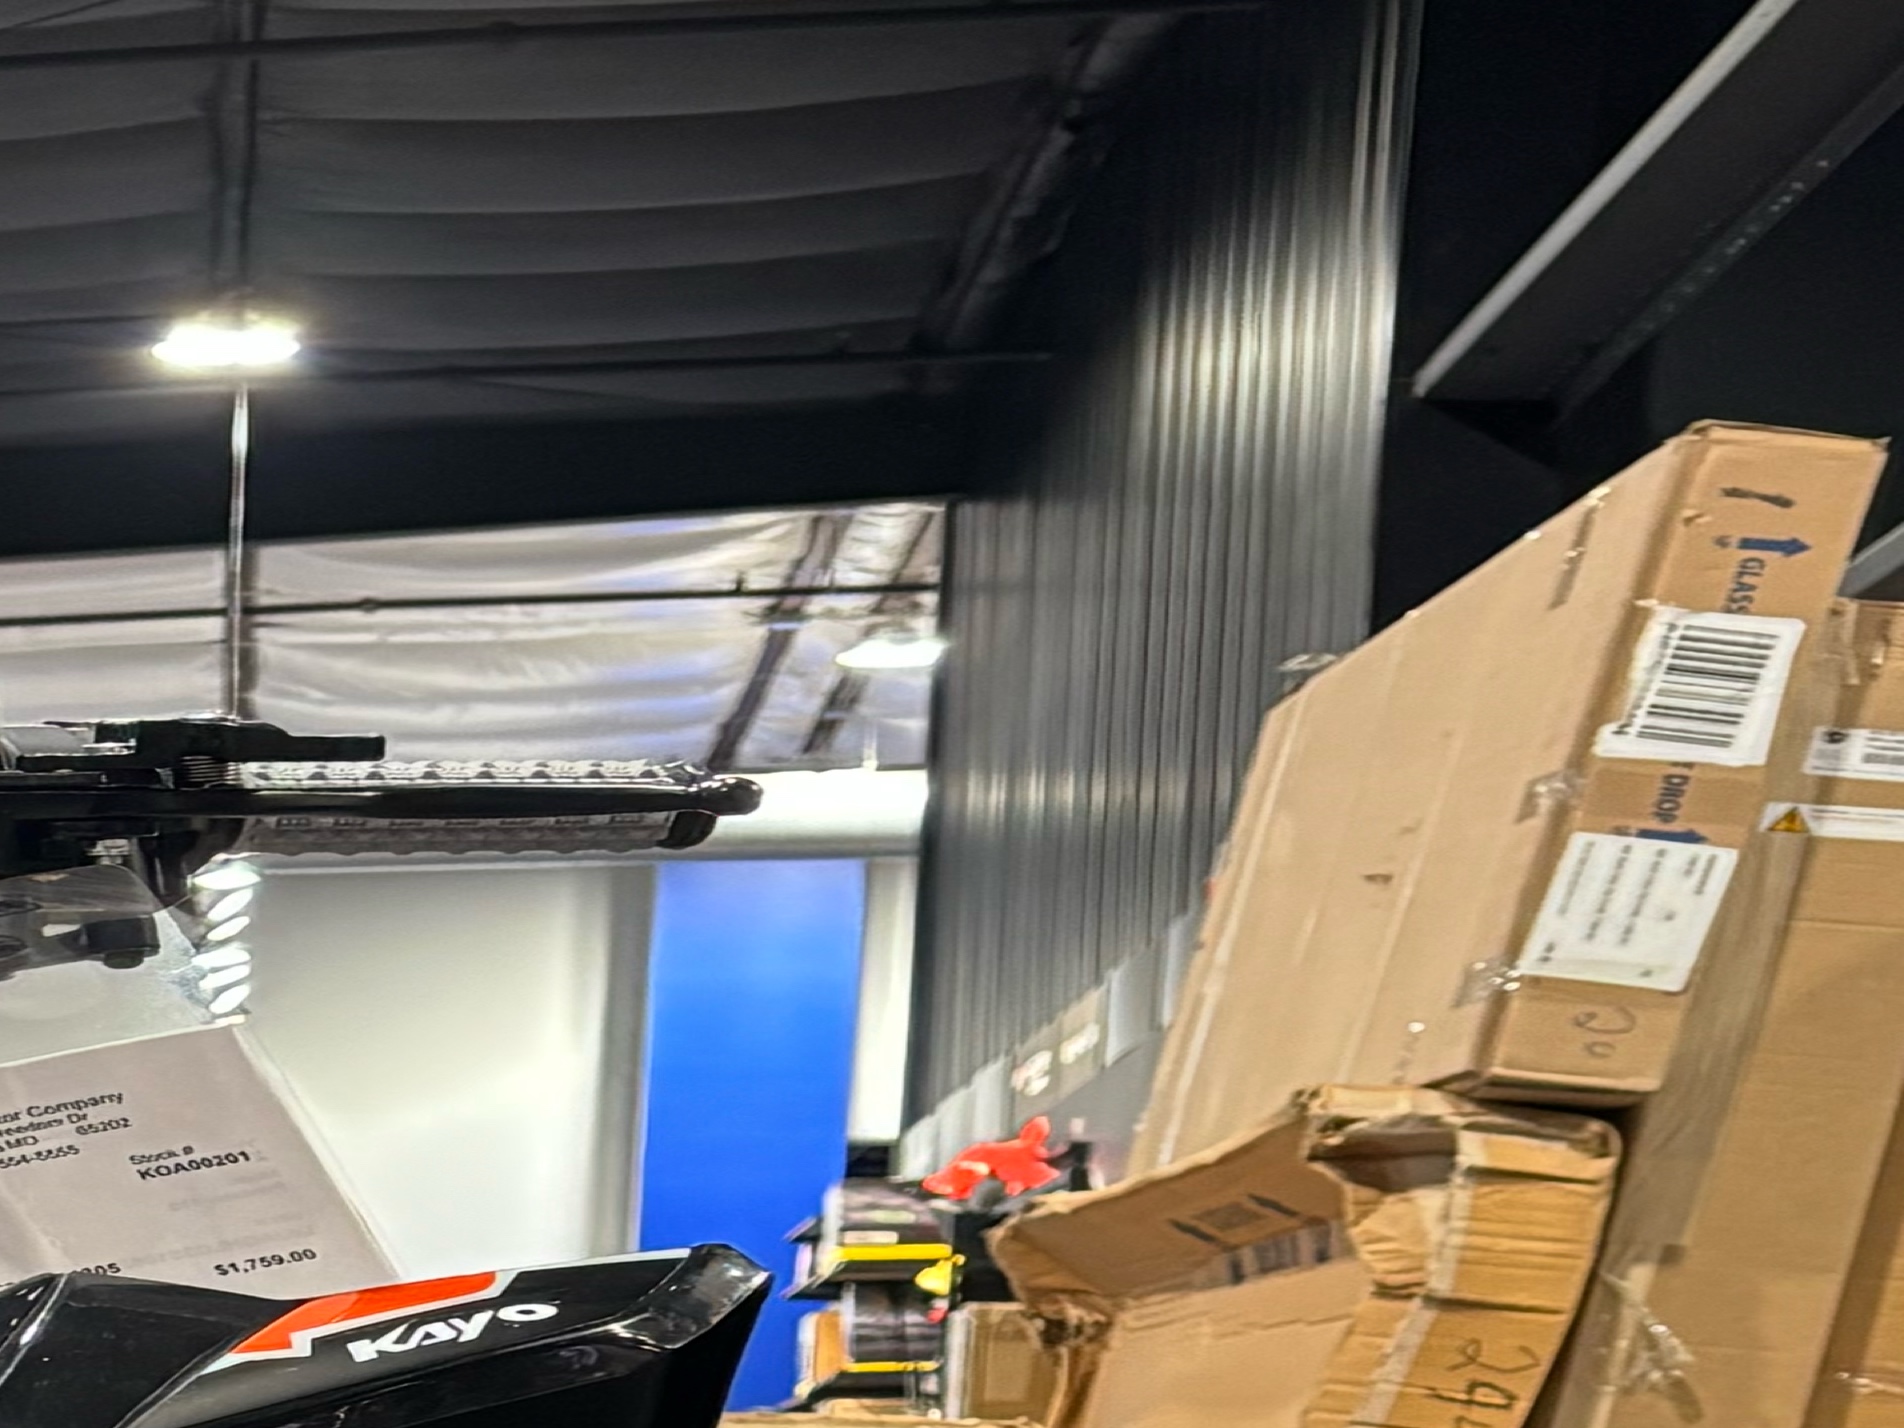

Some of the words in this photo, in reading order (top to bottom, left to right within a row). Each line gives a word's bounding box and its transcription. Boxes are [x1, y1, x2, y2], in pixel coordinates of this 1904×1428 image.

[1649, 774, 1691, 824] DROP
[27, 1092, 124, 1119] Company
[213, 1249, 317, 1276] $1,759.00
[348, 1301, 560, 1365] KAYO
